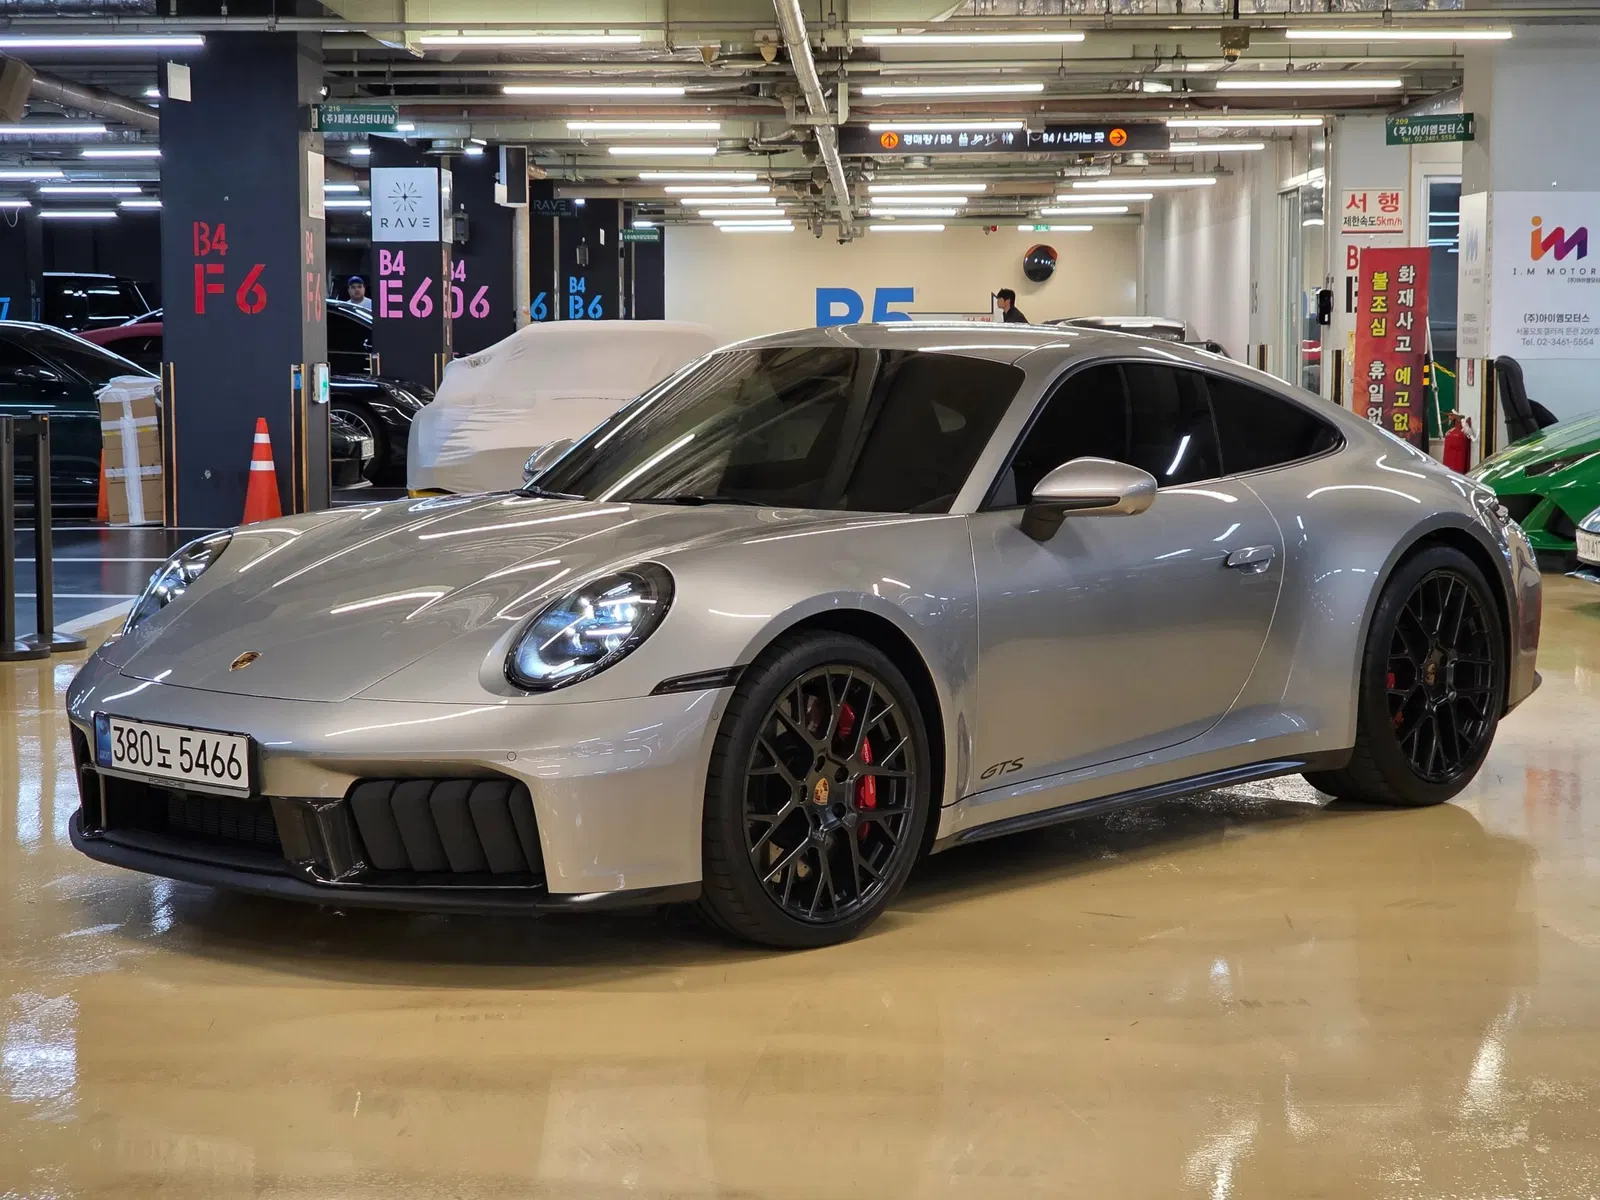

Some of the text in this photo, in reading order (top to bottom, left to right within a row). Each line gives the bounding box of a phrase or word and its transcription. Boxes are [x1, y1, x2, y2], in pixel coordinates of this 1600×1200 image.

[1042, 132, 1055, 143] B4
[1062, 131, 1092, 143] 나가는
[1393, 123, 1465, 137] (주)아이엠모터스
[533, 199, 566, 211] RAVE
[380, 217, 431, 228] RAVE
[193, 221, 229, 256] B4
[379, 249, 406, 276] B4
[379, 276, 433, 318] E6
[568, 276, 586, 294] B4
[1369, 271, 1389, 337] 불조심
[1523, 313, 1590, 323] (주)아이엠모터스
[1392, 264, 1416, 441] 화재사고 예고없
[112, 725, 242, 781] 380노 5466
[980, 756, 1025, 780] GTS
